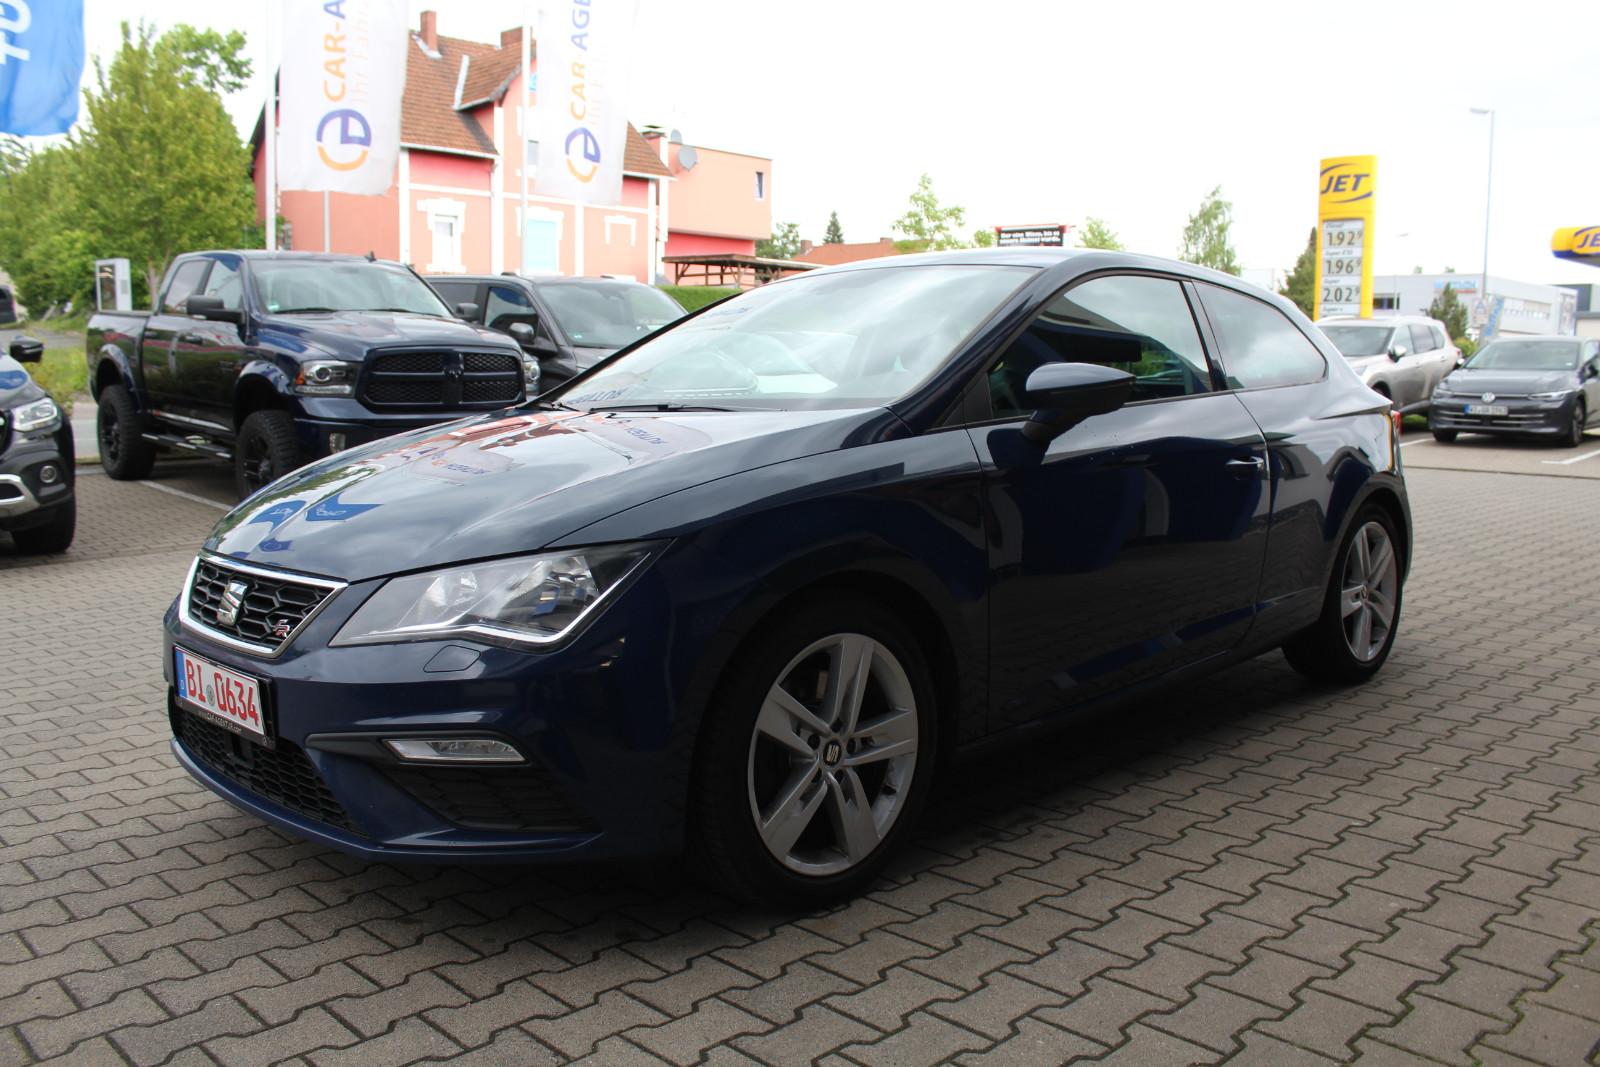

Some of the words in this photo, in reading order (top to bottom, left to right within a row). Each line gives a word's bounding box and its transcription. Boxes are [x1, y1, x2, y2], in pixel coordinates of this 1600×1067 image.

[1320, 173, 1370, 194] JET
[185, 659, 206, 703] BI
[214, 672, 259, 727] 0634
